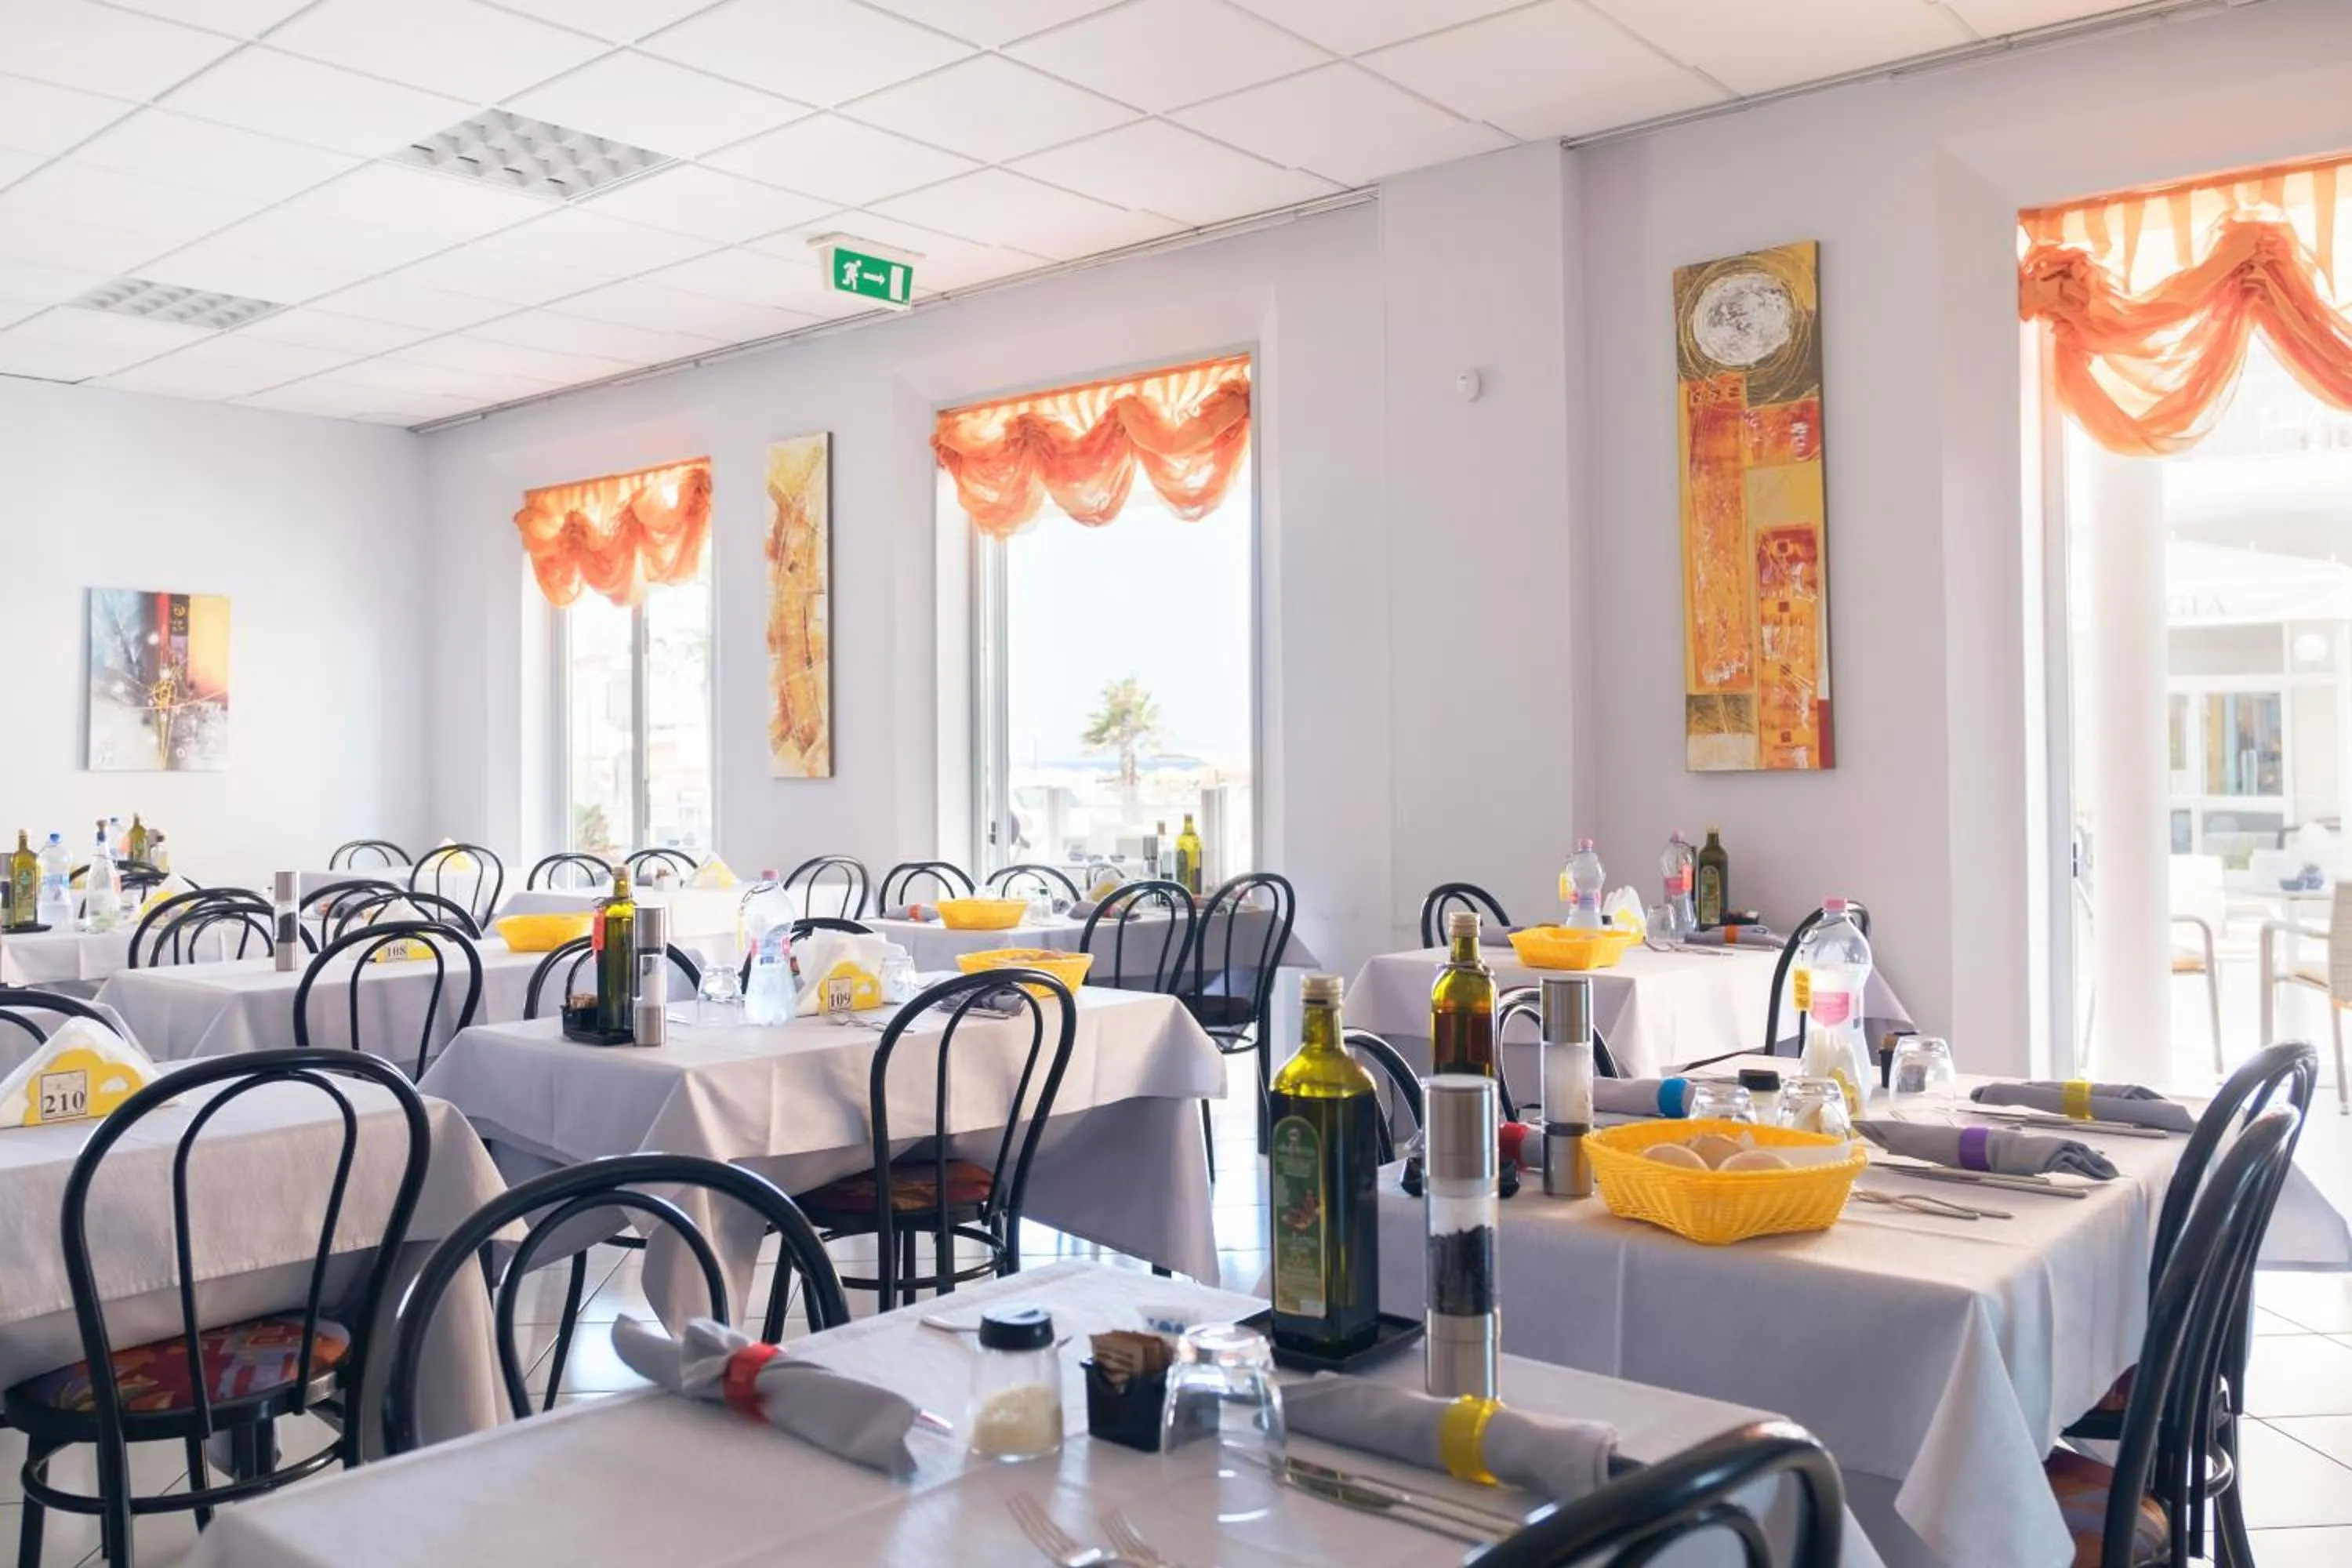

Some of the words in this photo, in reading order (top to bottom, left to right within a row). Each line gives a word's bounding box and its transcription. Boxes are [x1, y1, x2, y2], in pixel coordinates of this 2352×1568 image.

[387, 944, 407, 957] 108
[830, 991, 851, 1008] 109
[44, 1091, 85, 1113] 210
